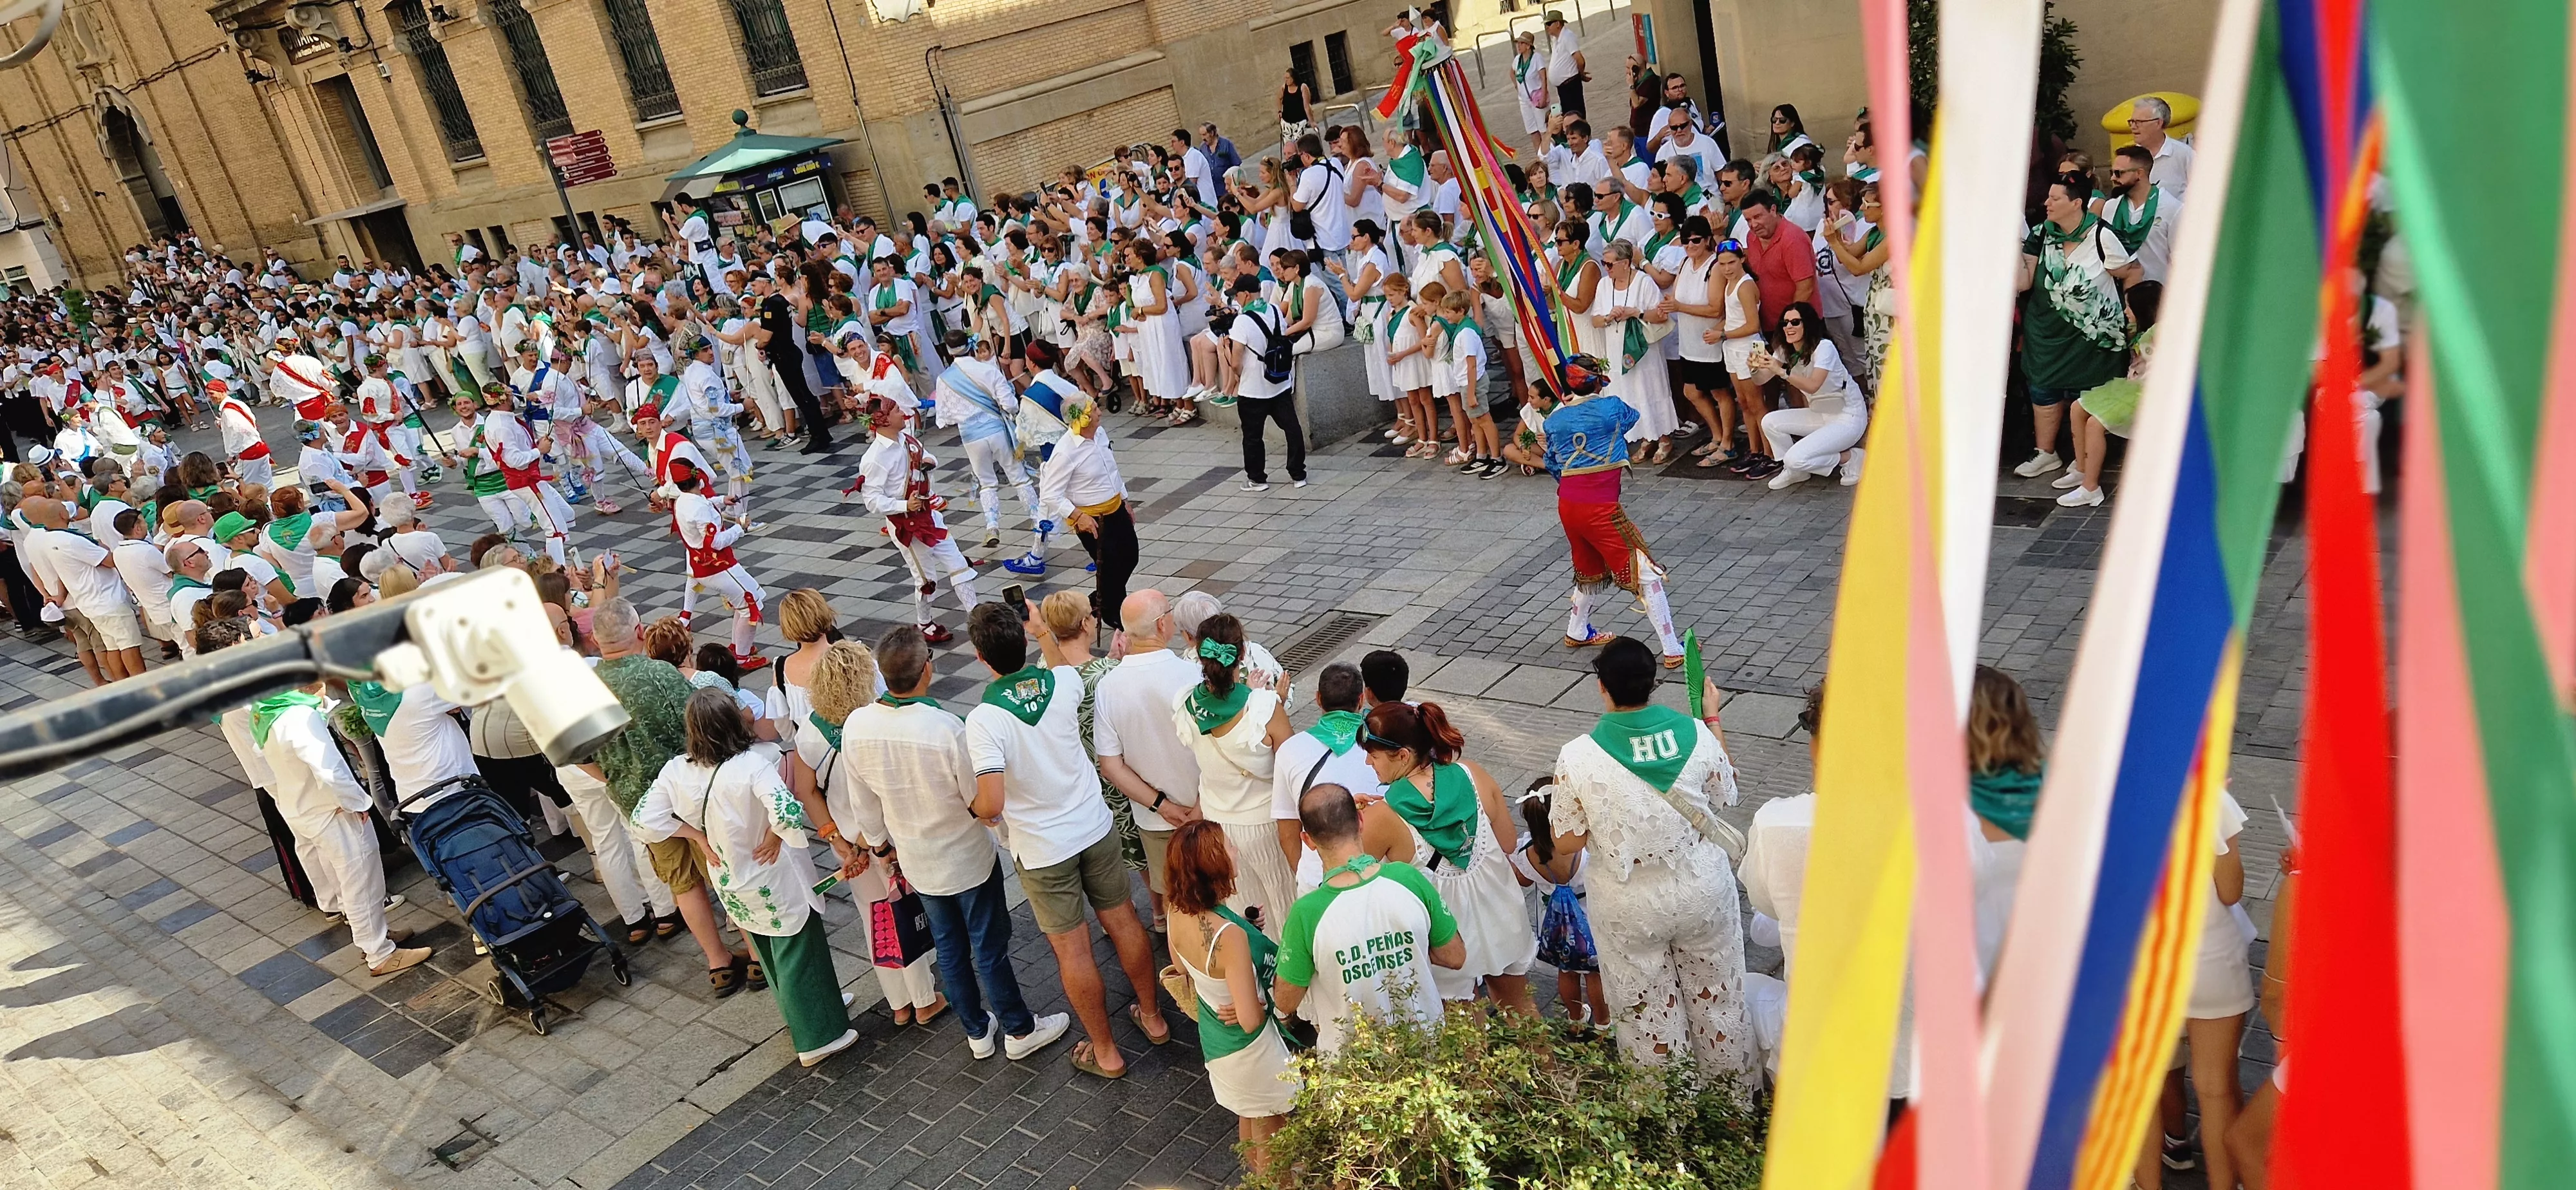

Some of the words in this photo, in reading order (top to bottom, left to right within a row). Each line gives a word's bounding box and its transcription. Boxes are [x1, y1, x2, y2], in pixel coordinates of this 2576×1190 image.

[1001, 688, 1021, 705] Peña
[1025, 701, 1038, 713] 10
[1629, 729, 1679, 763] HU
[1676, 798, 1695, 818] TOUS
[1336, 945, 1367, 966] C.D.
[1367, 930, 1414, 955] PEÑAS
[1342, 947, 1414, 984] OSCENSES
